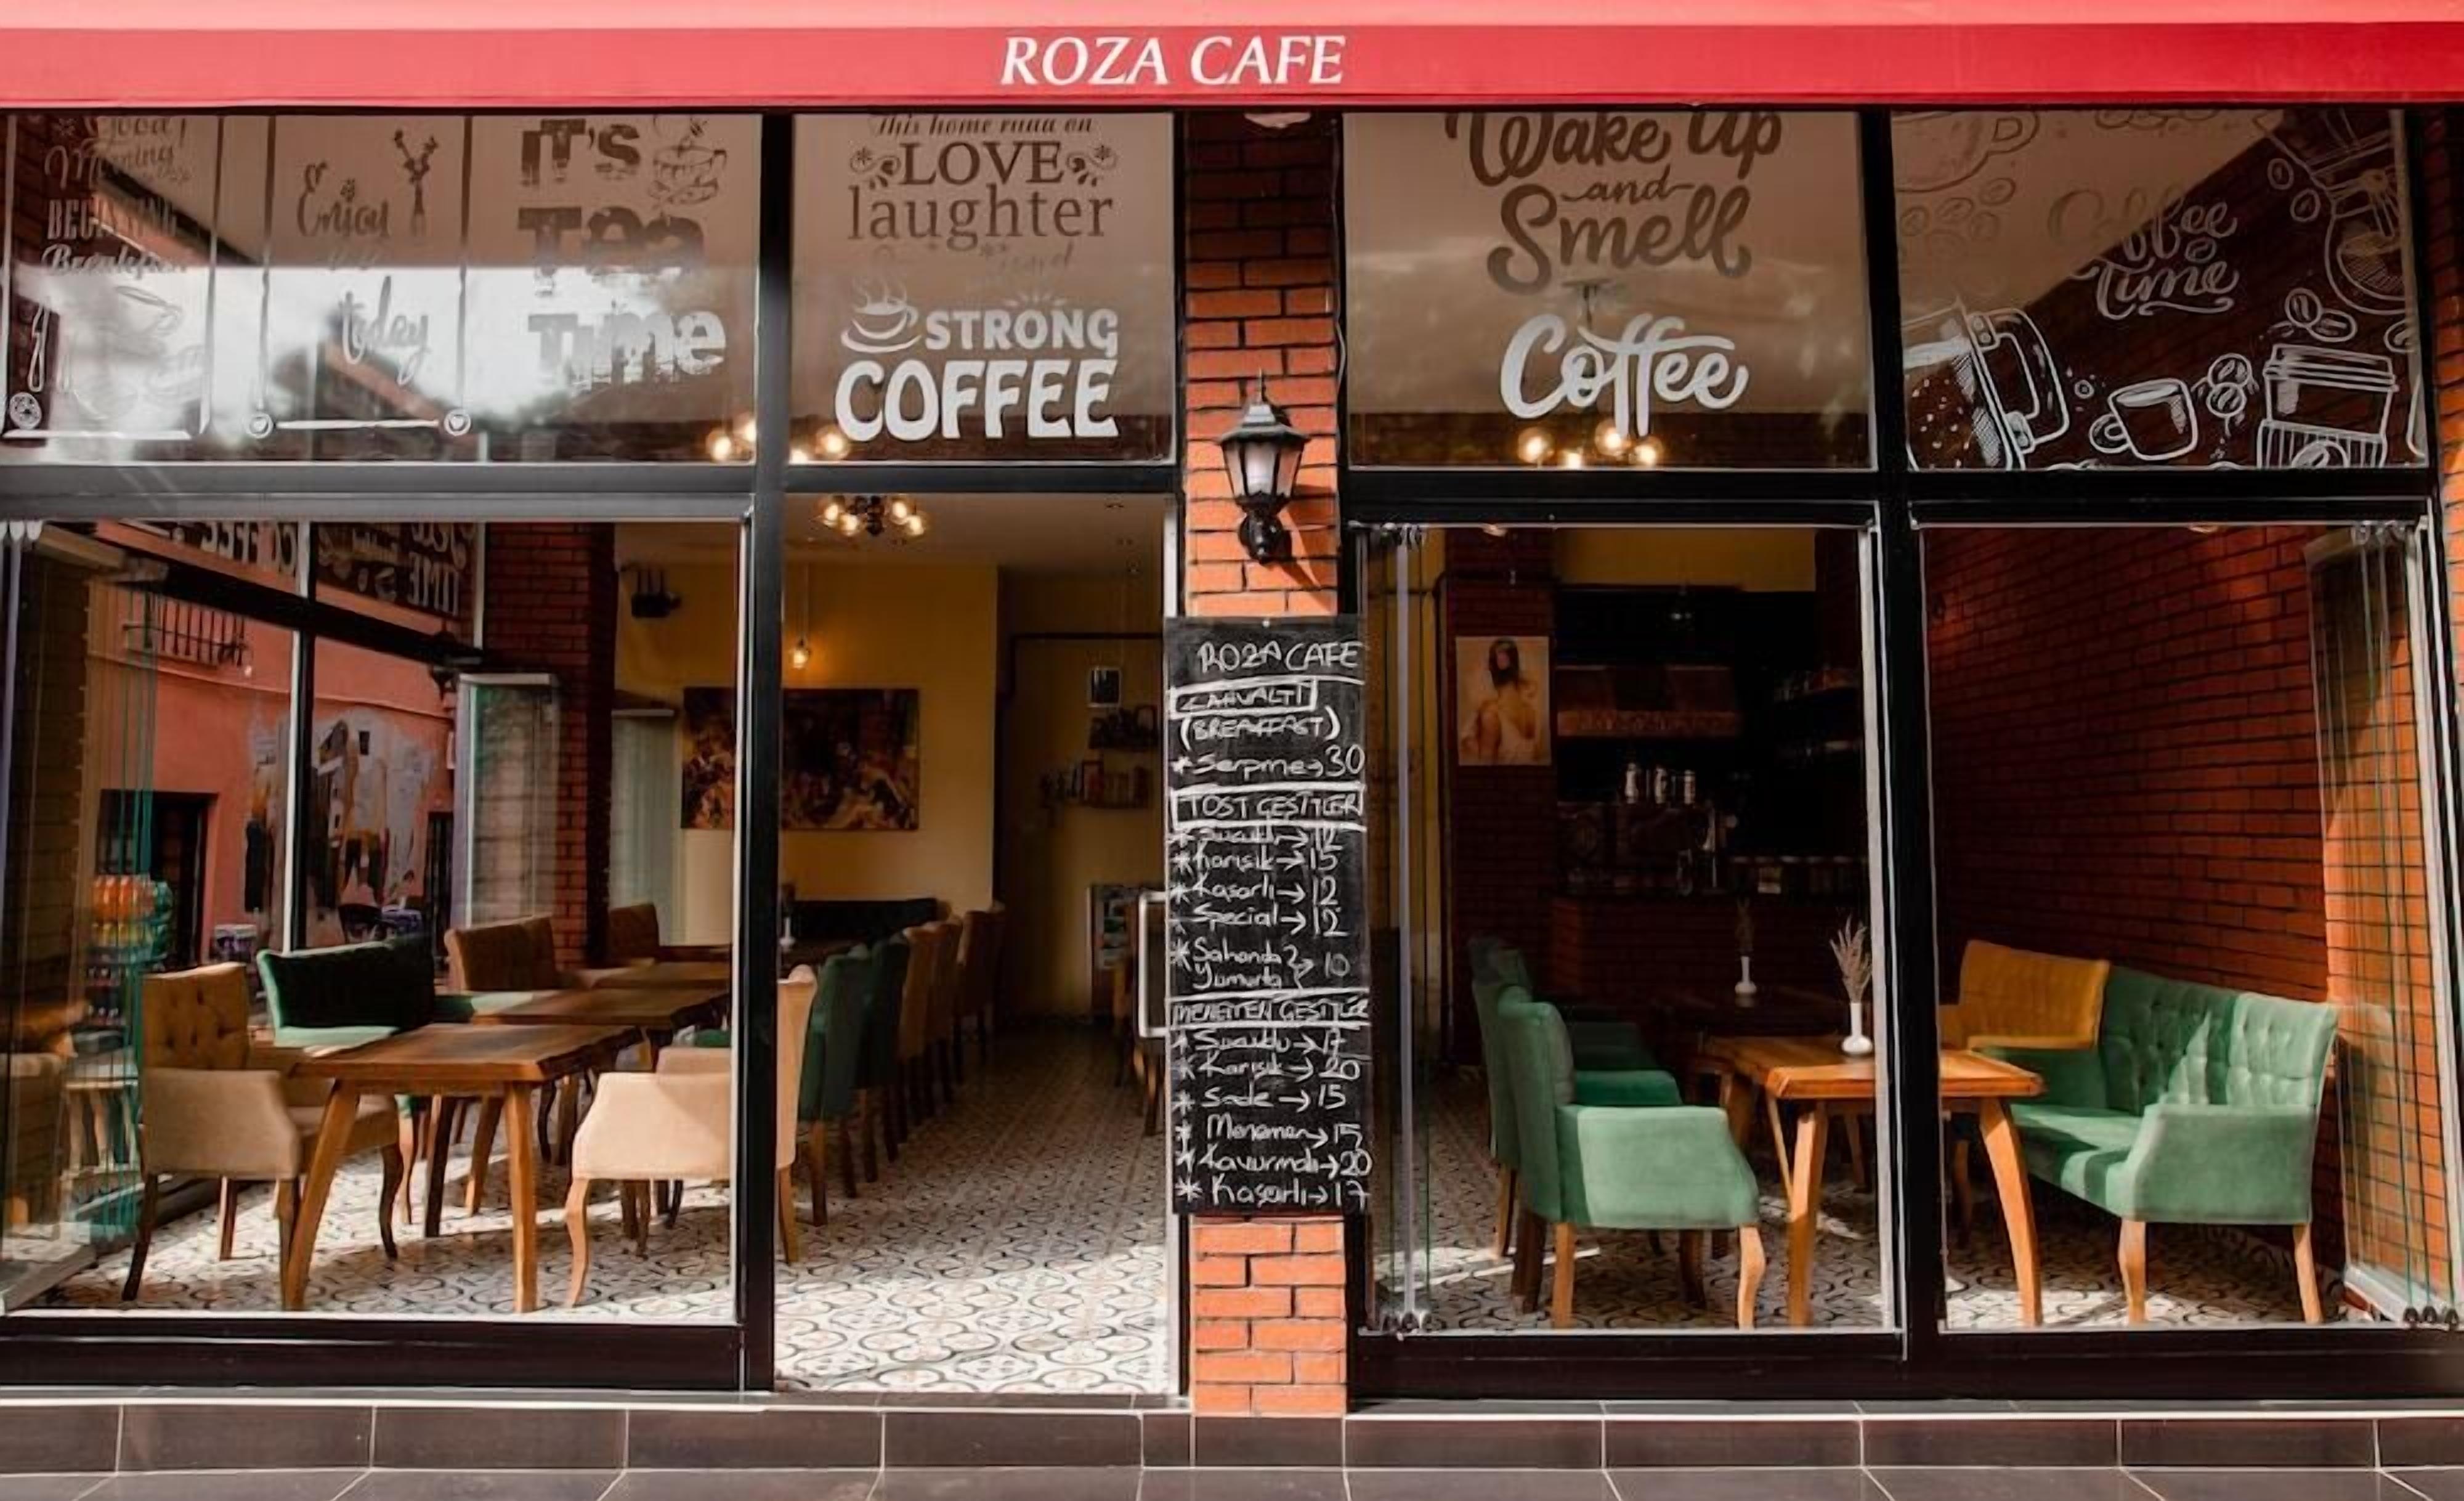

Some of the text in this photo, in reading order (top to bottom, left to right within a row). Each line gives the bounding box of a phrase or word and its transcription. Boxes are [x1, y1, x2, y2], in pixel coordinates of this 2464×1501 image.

[1000, 35, 1345, 86] ROZA CAFE
[521, 118, 641, 185] IT'S
[899, 141, 1065, 185] LOVE
[1562, 165, 1696, 204] and
[848, 185, 1113, 252] laughter
[1486, 185, 1753, 295] Smell
[925, 309, 1119, 357] STRONG
[1499, 312, 1749, 437] Coffee
[834, 359, 1119, 442] COFFEE
[1197, 640, 1363, 673] ROZA CAFE
[1325, 744, 1365, 777] 30
[1318, 1083, 1347, 1110] 15
